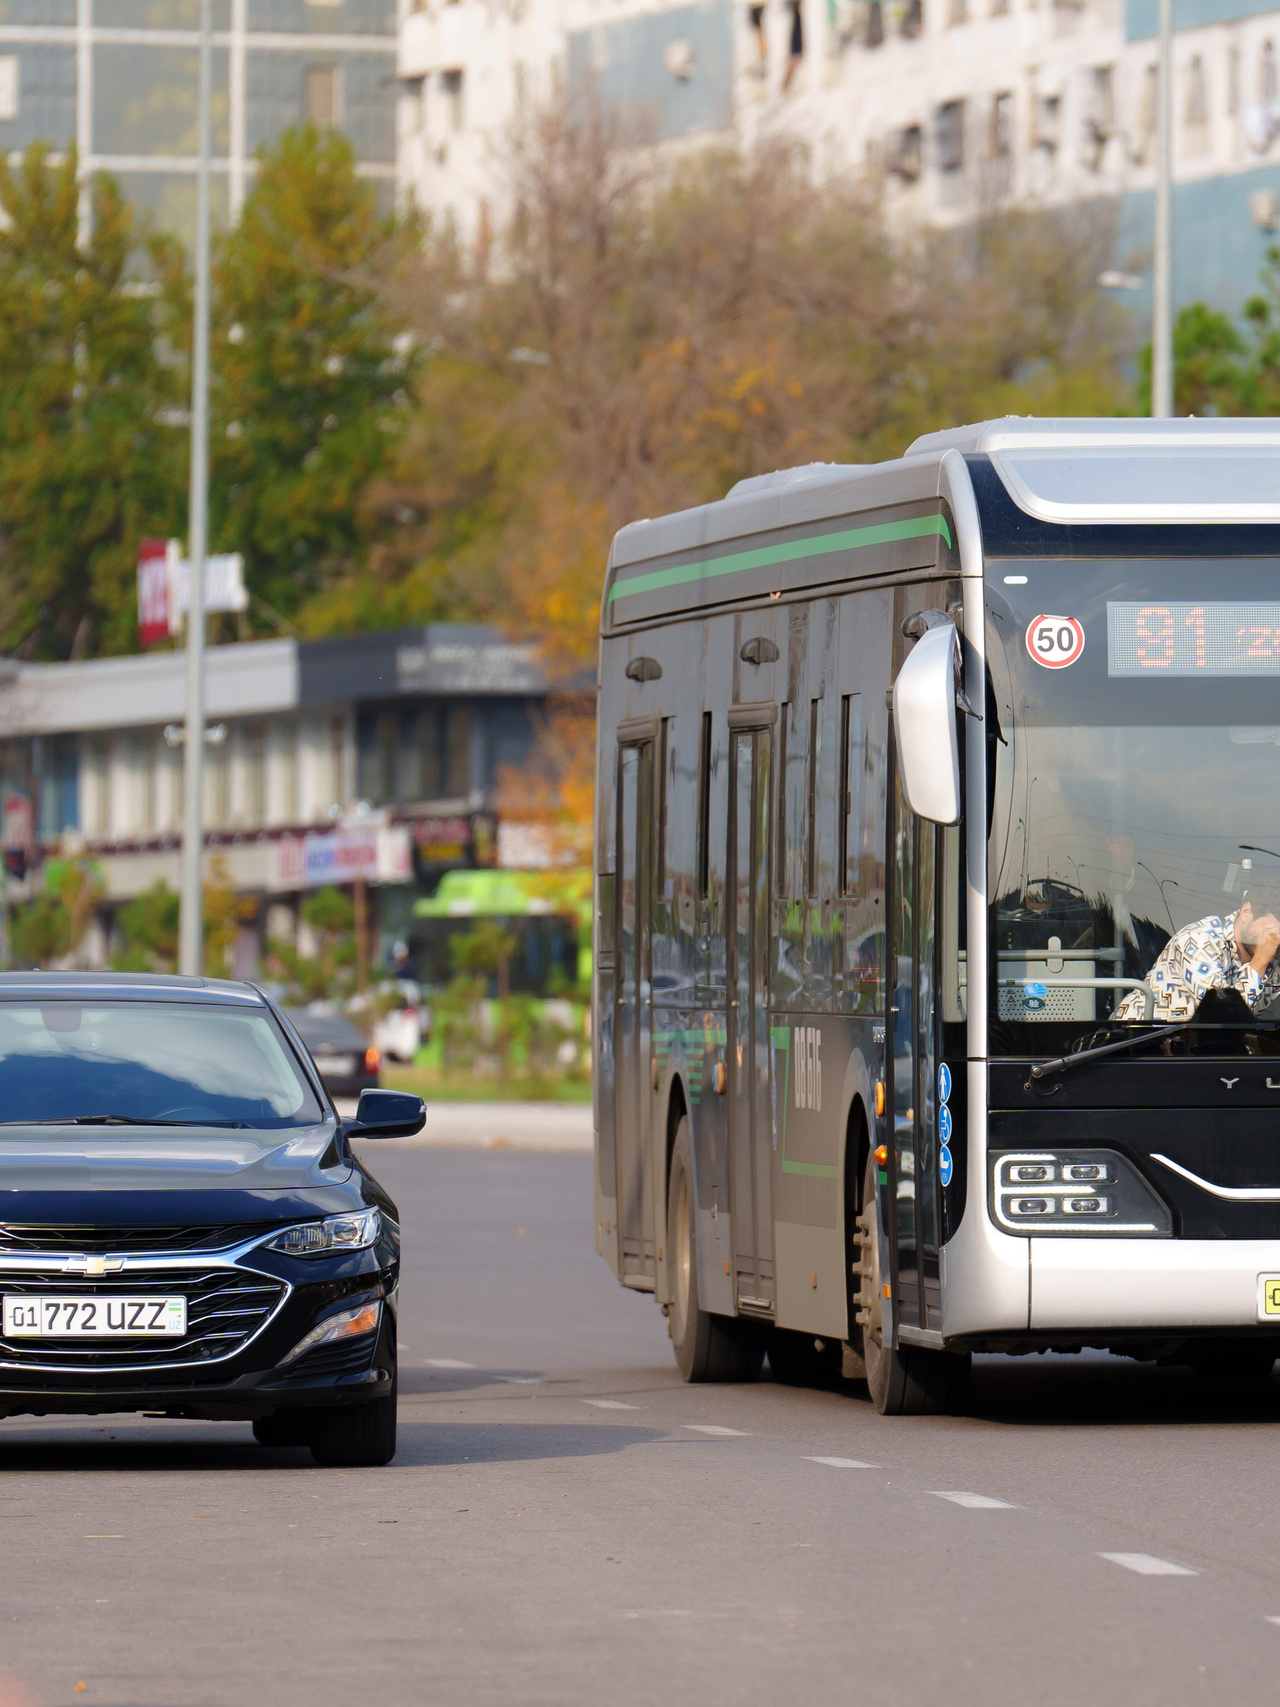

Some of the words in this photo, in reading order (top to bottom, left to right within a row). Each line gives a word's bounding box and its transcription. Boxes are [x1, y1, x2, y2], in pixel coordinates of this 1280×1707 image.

[1037, 626, 1074, 653] 50
[1136, 606, 1206, 668] 91
[12, 1306, 38, 1327] 01
[45, 1303, 97, 1330] 772
[106, 1302, 166, 1330] UZZ
[168, 1320, 182, 1330] UZ
